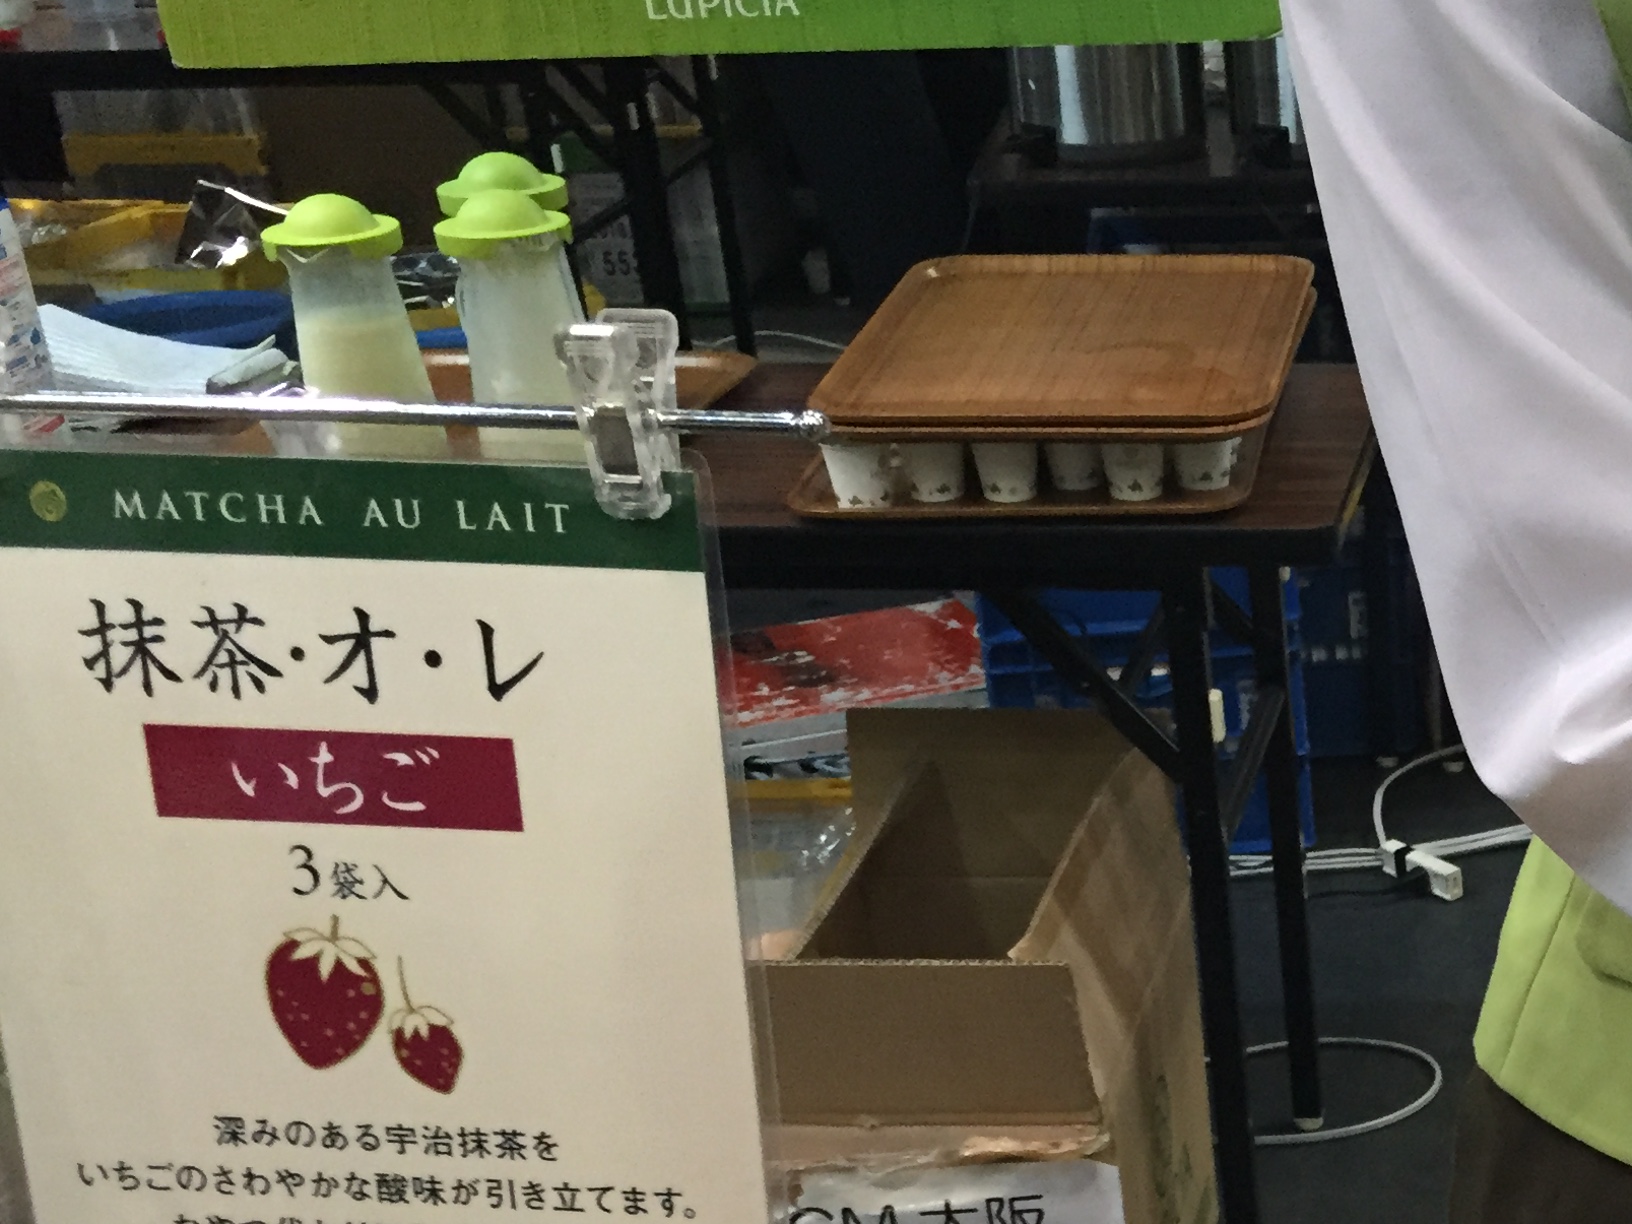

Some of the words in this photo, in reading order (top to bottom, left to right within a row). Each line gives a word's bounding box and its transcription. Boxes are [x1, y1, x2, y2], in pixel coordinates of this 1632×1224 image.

[645, 0, 801, 20] LUPICIA
[114, 490, 323, 525] MATCHA
[363, 498, 420, 529] AU
[456, 500, 569, 533] LAIT
[77, 598, 544, 705] 抹茶・オ・レ
[231, 741, 440, 814] いちご
[290, 844, 410, 901] 3袋入
[213, 1115, 559, 1162] 深みのある宇治抹茶を
[76, 1160, 696, 1219] いちごのさわやかな酸味が引き立てます。
